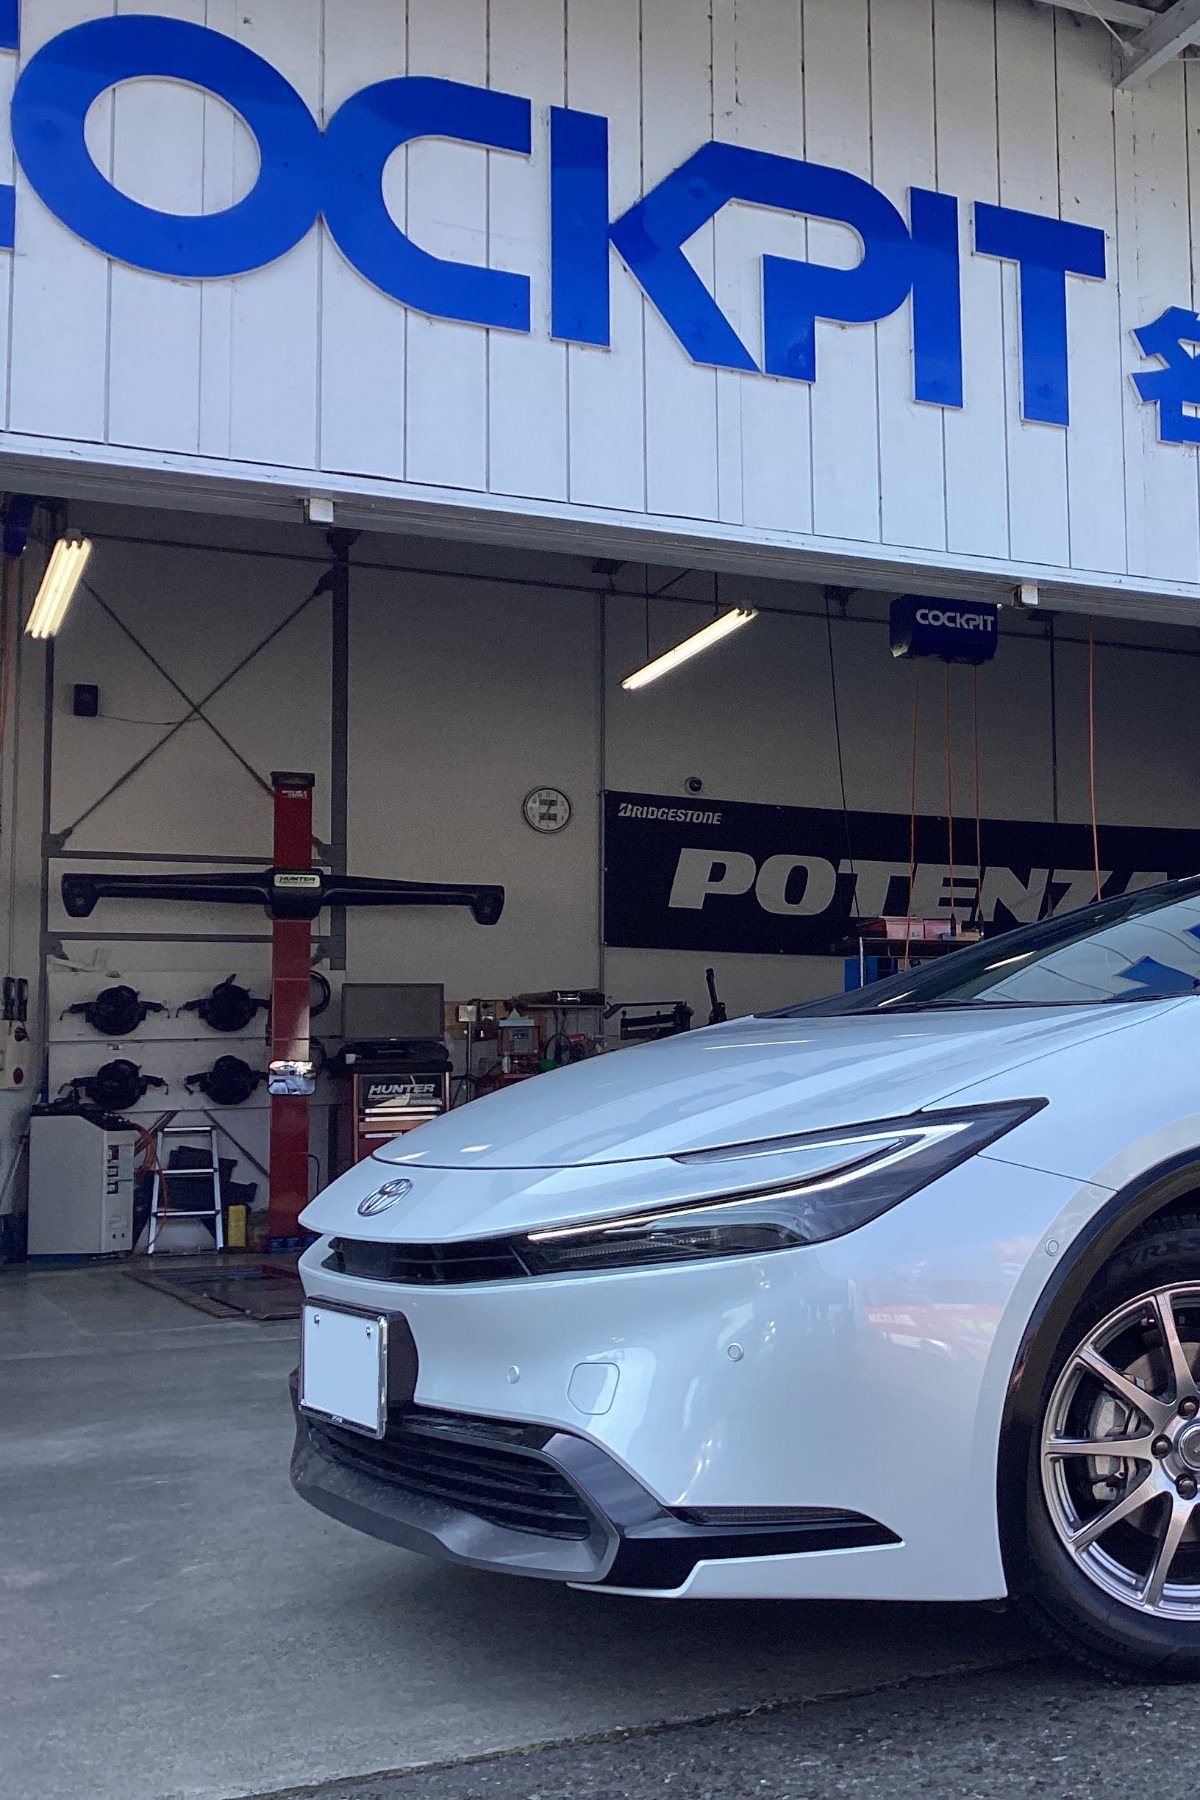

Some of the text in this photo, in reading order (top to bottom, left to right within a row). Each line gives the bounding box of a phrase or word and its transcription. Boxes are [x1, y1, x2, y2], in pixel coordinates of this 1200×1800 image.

[0, 0, 1106, 428] OCKPIT
[915, 608, 995, 632] COCKPIT
[618, 803, 722, 825] BRIDGESTONE
[368, 1083, 436, 1095] HUNTER
